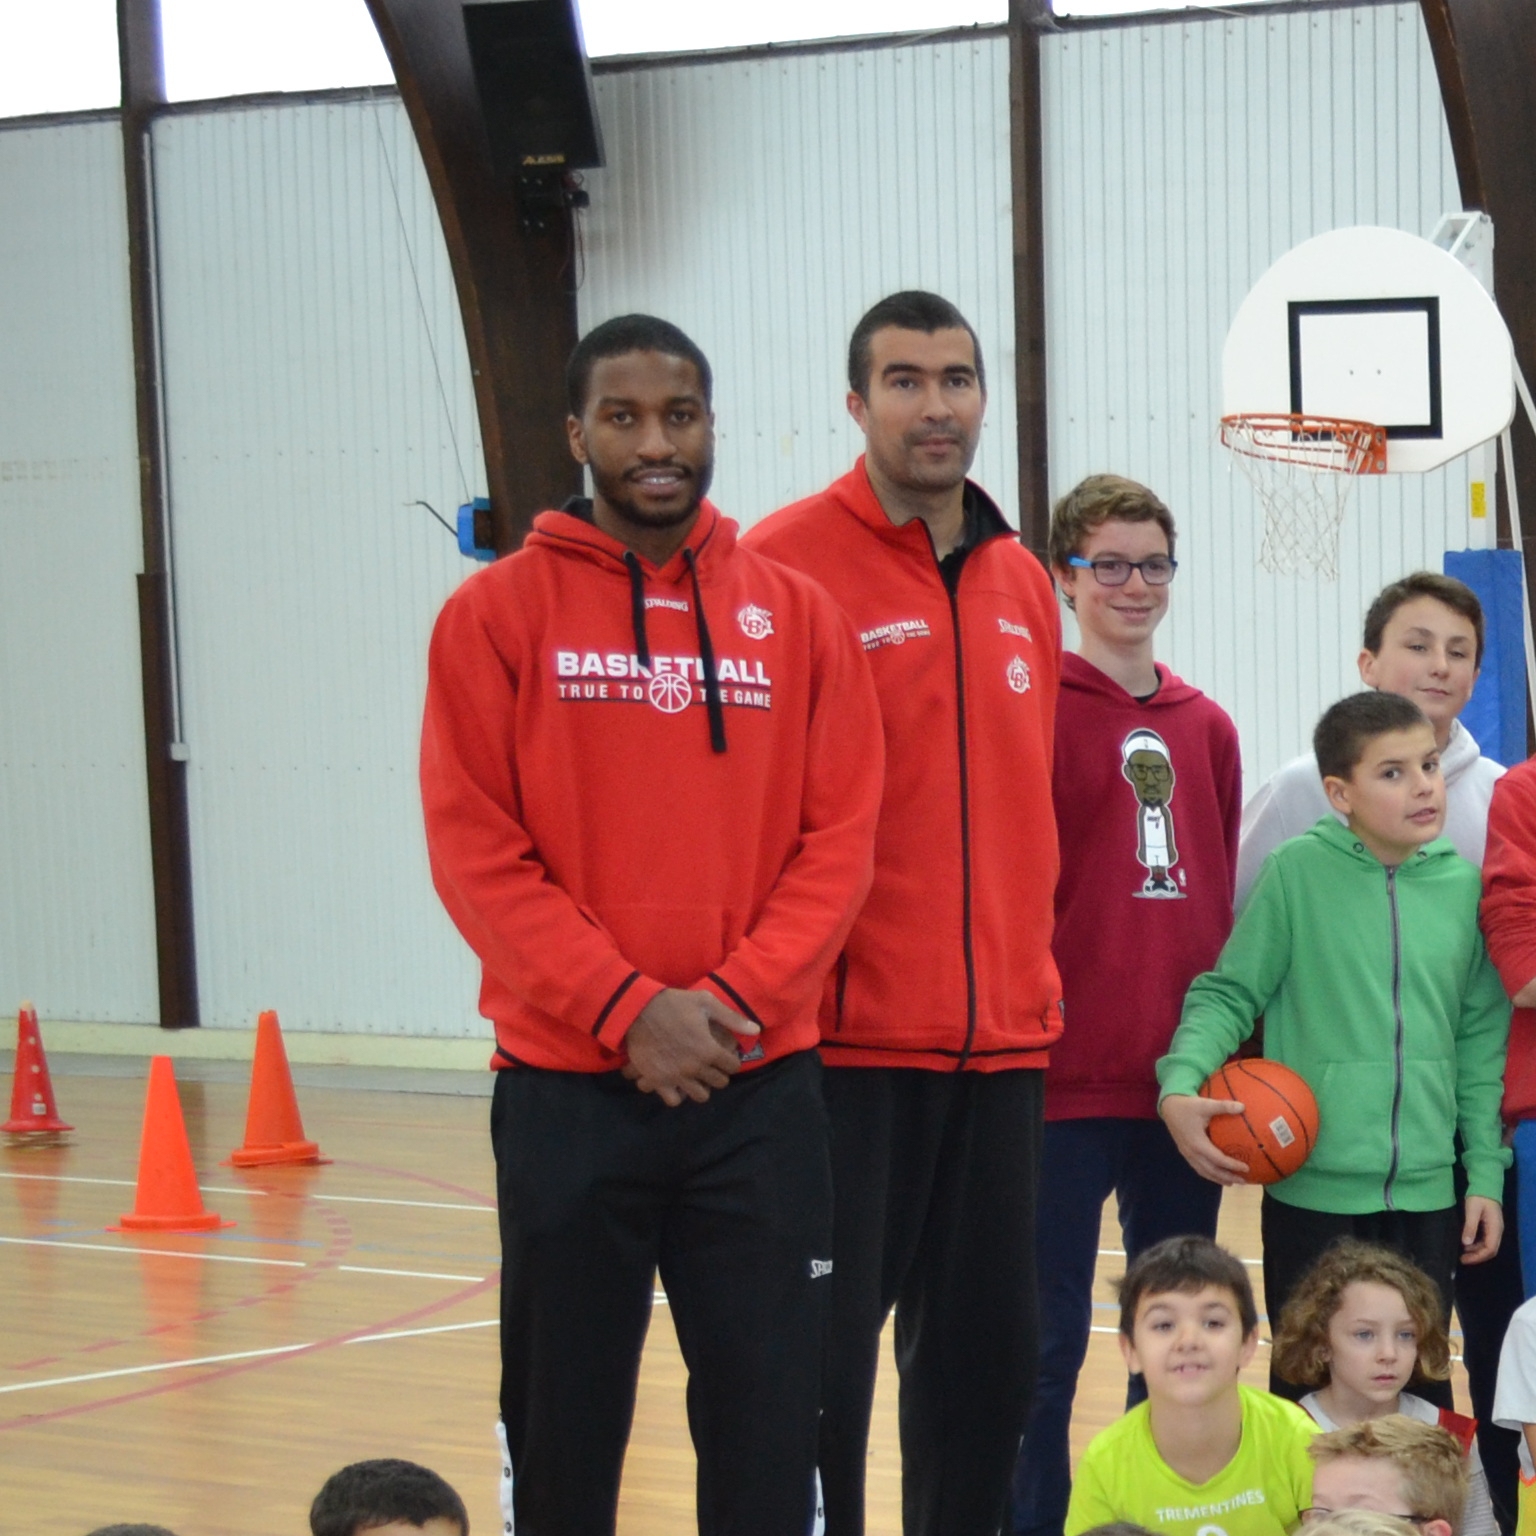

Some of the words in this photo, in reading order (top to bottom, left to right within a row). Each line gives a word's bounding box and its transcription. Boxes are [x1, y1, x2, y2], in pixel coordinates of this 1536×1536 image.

[558, 683, 608, 699] TRUE
[619, 684, 643, 701] TO
[699, 687, 728, 704] TE
[733, 689, 772, 709] GAME
[1155, 1488, 1266, 1523] TREMENTINES
